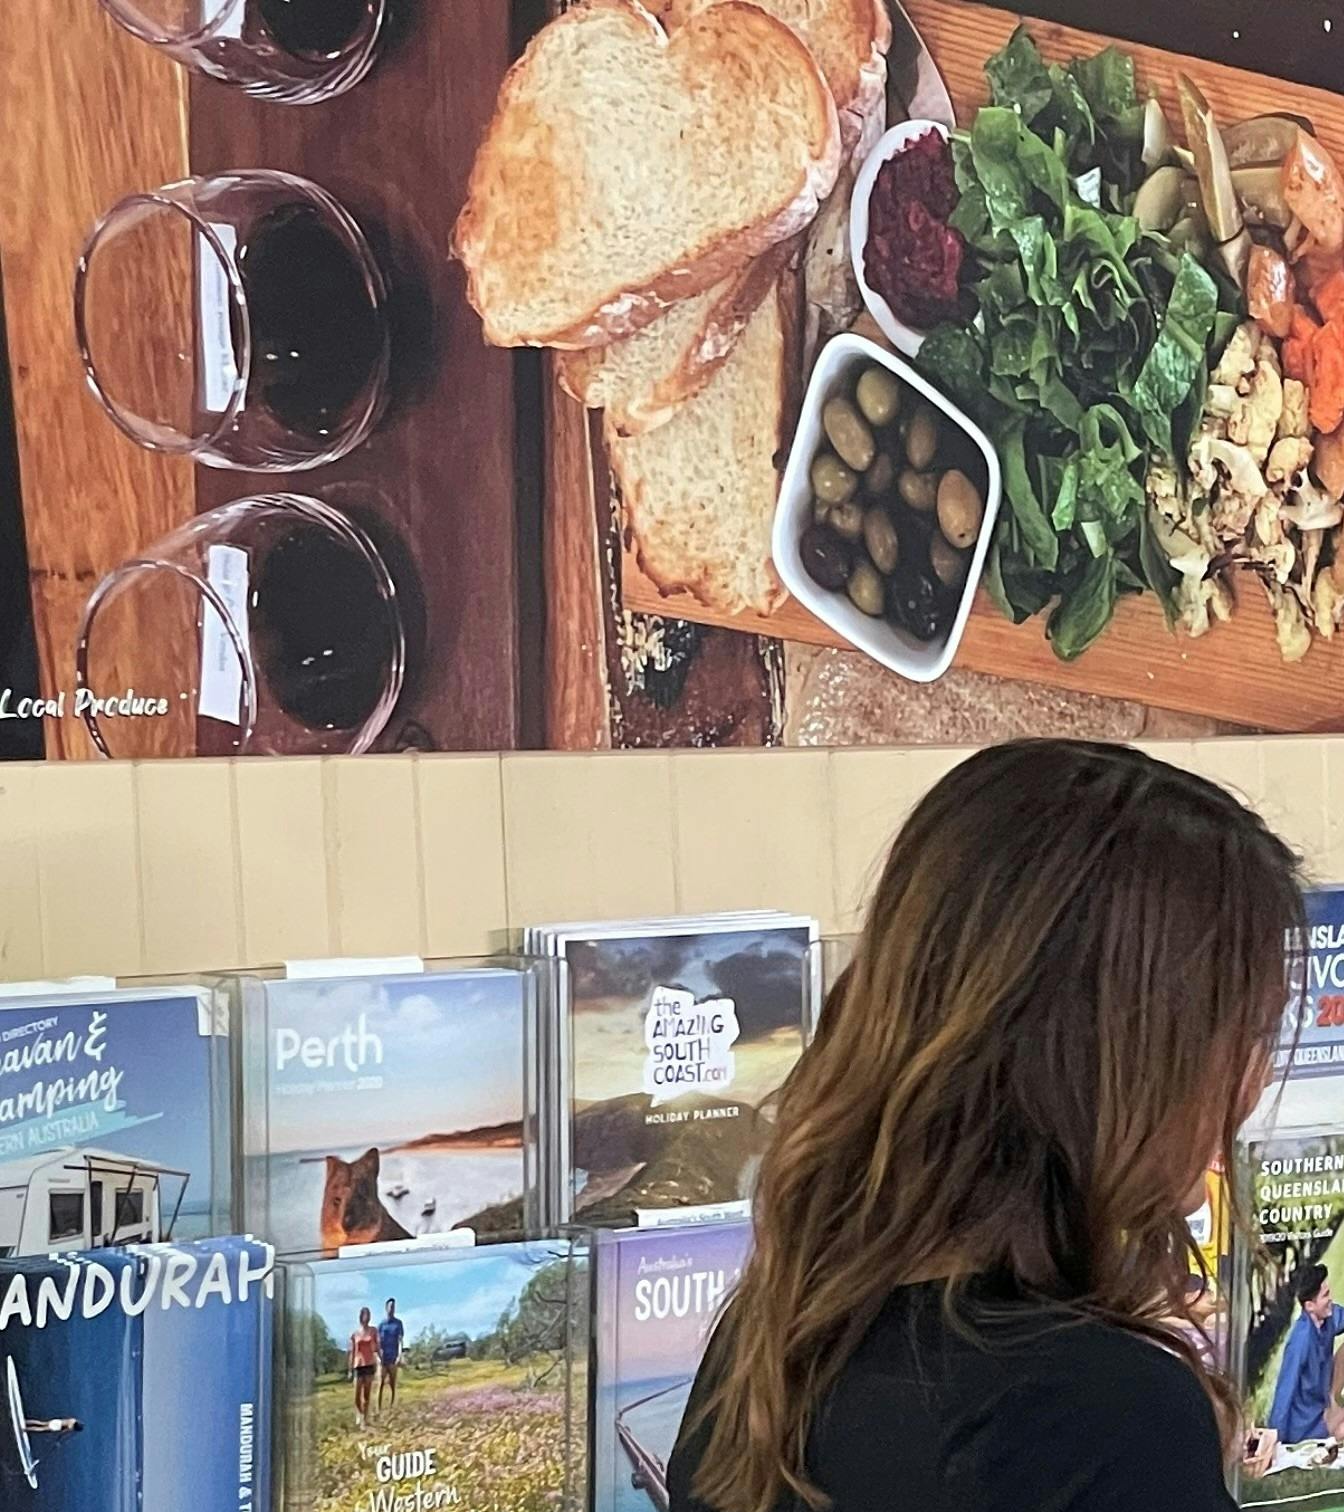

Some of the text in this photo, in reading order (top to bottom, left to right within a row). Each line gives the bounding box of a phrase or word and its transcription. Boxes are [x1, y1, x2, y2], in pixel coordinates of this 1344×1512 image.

[0, 688, 169, 719] Local Produce
[655, 997, 681, 1017] the
[276, 1012, 384, 1072] Perth
[654, 1038, 711, 1063] SOUTH
[28, 1111, 99, 1148] AUSTRALIA
[645, 1106, 740, 1125] HOLIDAY PLANNER
[1261, 1155, 1344, 1177] SOUTHERN
[1259, 1203, 1333, 1226] COUNTRY
[635, 1270, 725, 1321] SOUTH
[376, 1448, 438, 1483] GUIDE
